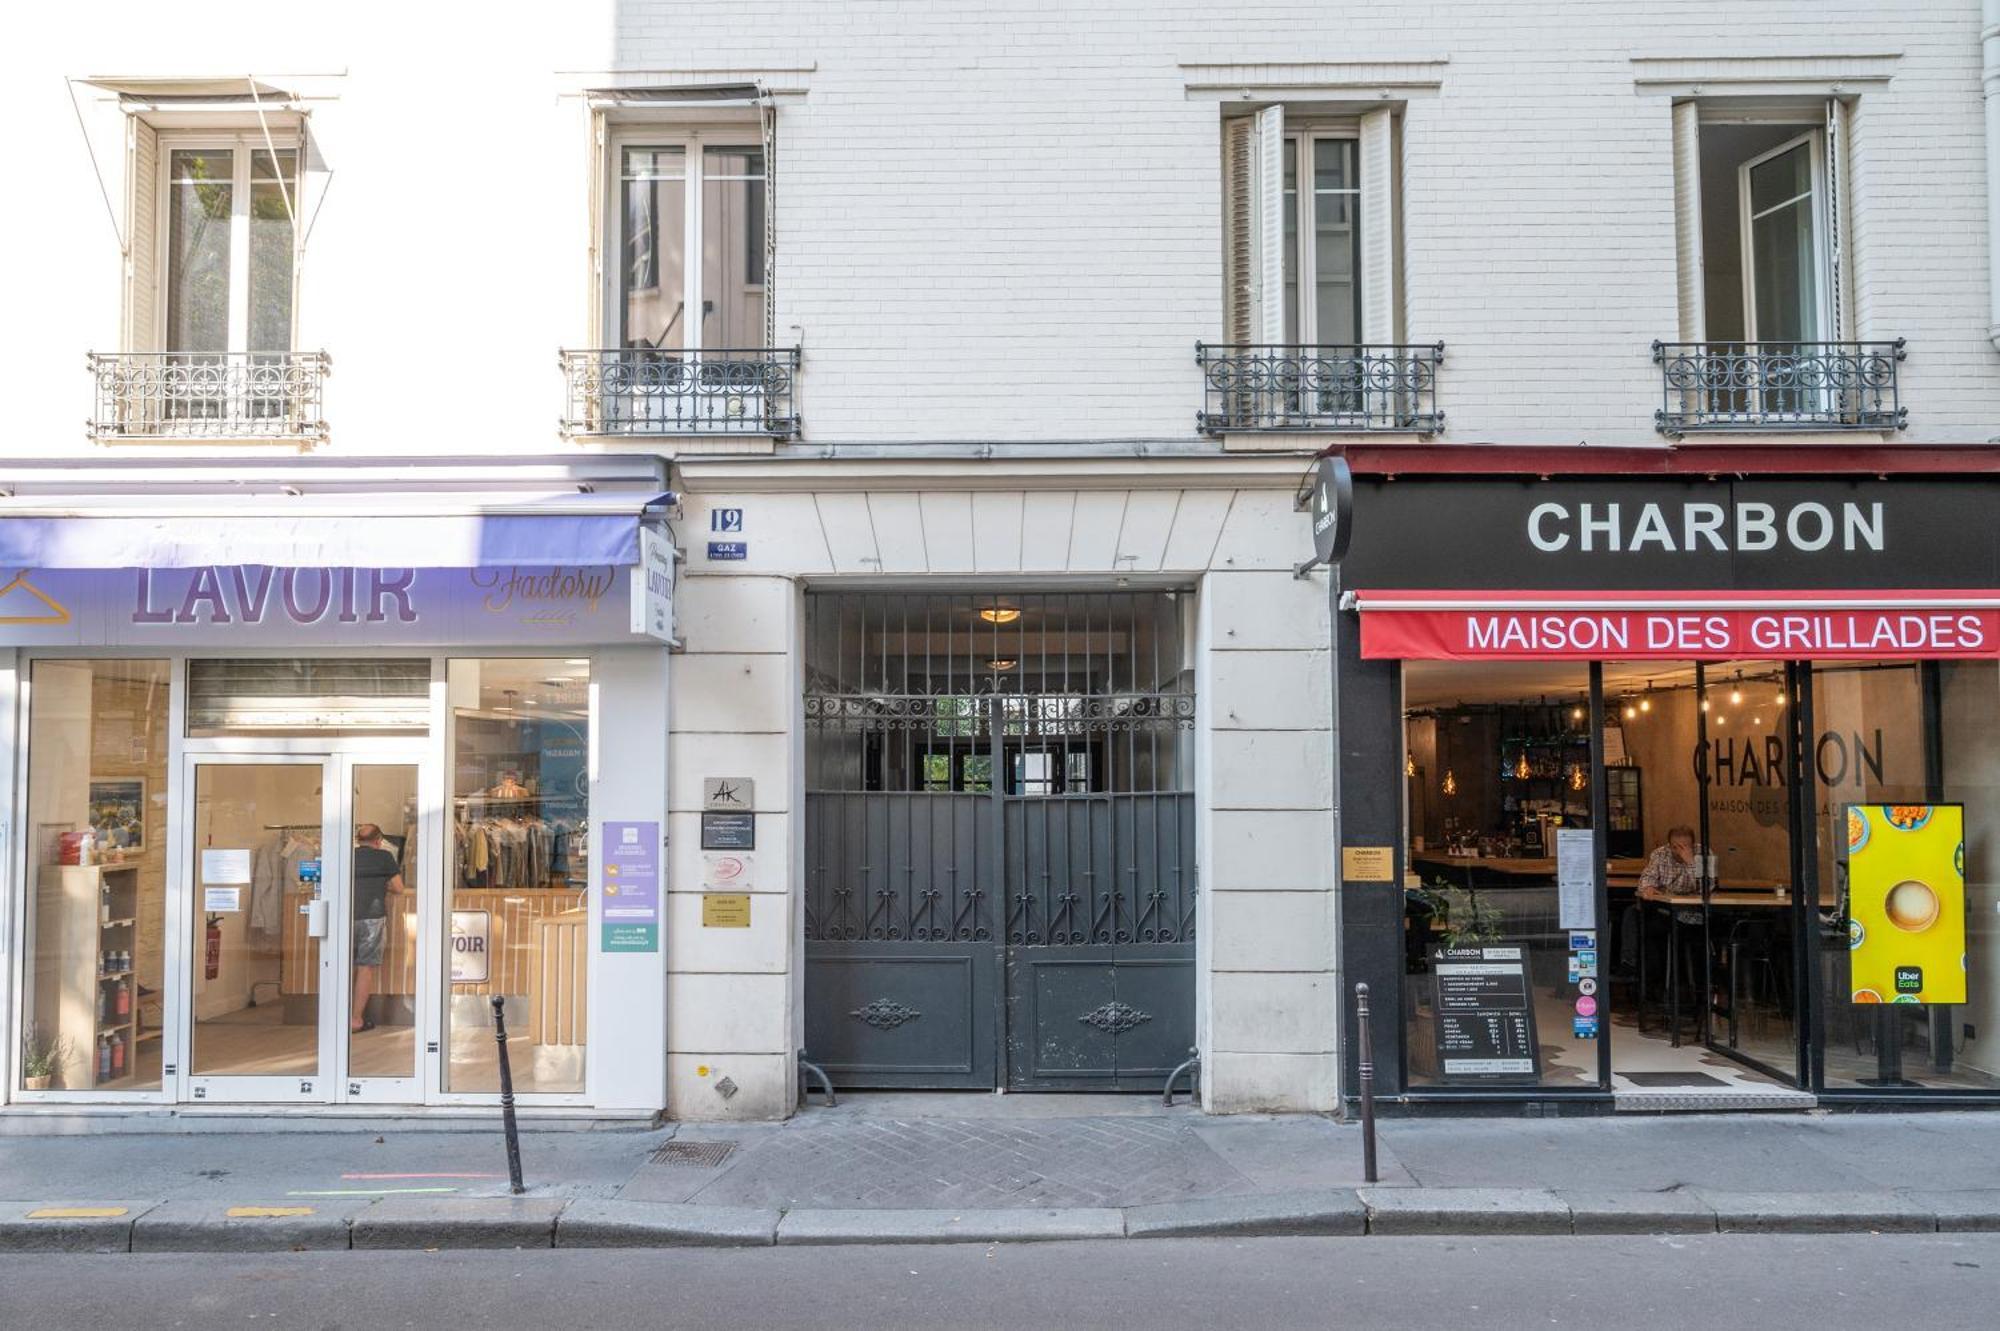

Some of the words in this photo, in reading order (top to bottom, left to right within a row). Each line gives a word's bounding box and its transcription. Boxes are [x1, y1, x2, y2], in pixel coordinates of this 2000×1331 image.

[715, 510, 740, 532] 12
[1527, 502, 1885, 551] CHARBON
[132, 565, 418, 624] LAVOIR
[1466, 617, 1629, 650] MAISON
[1647, 617, 1730, 649] DES
[1750, 615, 1984, 649] GRILLADES
[1693, 729, 1884, 787] CHARON
[1898, 971, 1919, 980] Uber
[1898, 980, 1919, 988] Eats
